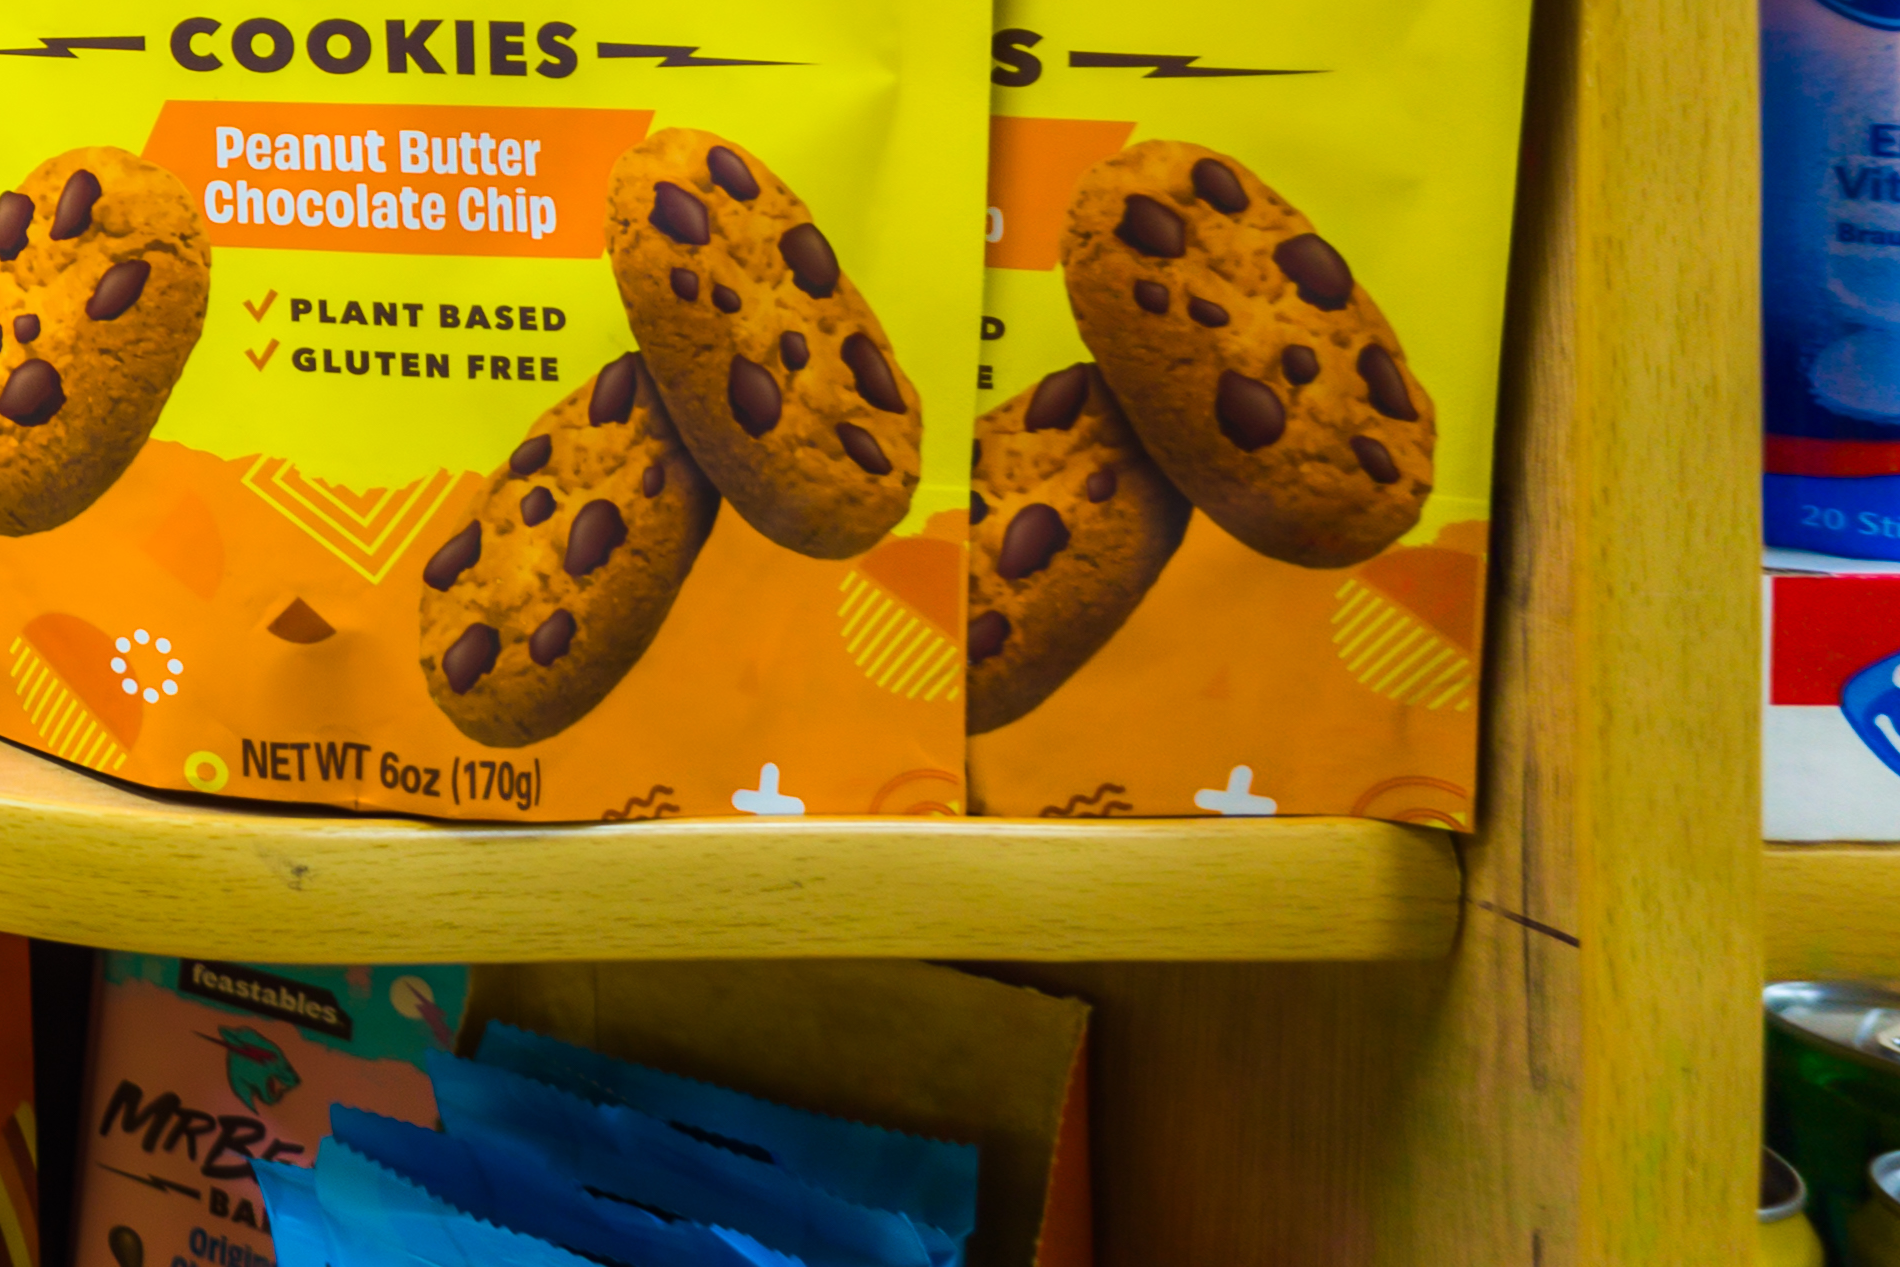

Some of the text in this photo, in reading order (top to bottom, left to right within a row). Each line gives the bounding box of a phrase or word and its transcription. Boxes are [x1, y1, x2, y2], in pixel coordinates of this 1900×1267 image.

[169, 16, 580, 79] COOKIES
[214, 126, 542, 177] Peanut Butter
[203, 179, 558, 240] Chocolate Chip
[290, 297, 567, 333] PLANT BASED
[291, 346, 560, 382] GLUTEN FREE
[1800, 504, 1847, 531] 20
[241, 737, 541, 811] NET WT 6oz (170g)
[192, 963, 340, 1025] feastables
[100, 1079, 307, 1181] MRBE
